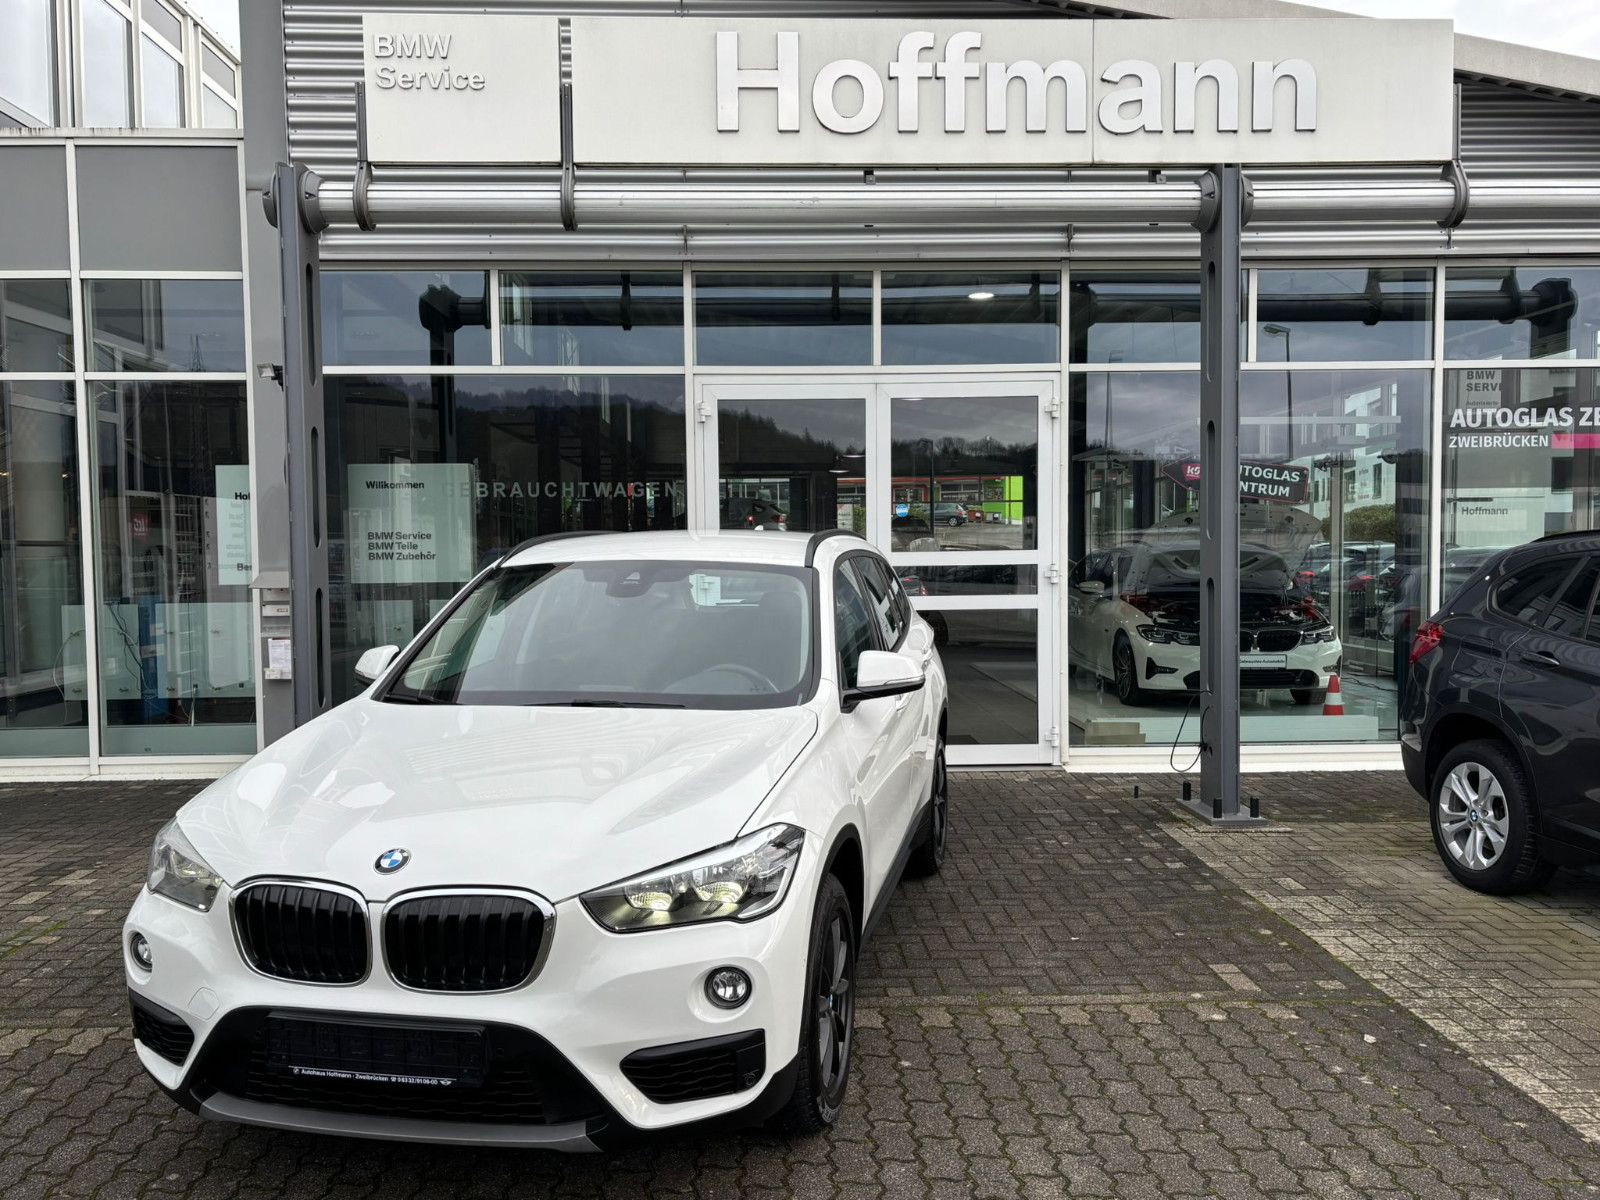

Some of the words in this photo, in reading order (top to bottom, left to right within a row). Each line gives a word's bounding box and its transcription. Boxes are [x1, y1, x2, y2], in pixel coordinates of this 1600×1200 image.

[373, 33, 451, 59] BMW
[376, 66, 486, 90] Service
[716, 30, 1318, 135] Hoffmann
[1466, 370, 1495, 380] BMW
[1466, 382, 1502, 392] SERVI
[1450, 406, 1573, 427] AUTOGLAS
[1578, 406, 1600, 426] ZE
[1449, 432, 1548, 448] ZWEIBRÜCKEN
[1240, 465, 1300, 482] TOGLAS
[365, 480, 425, 489] Willkommen
[1240, 481, 1290, 497] NTRUM
[1461, 506, 1508, 516] Hoffmann
[367, 531, 394, 540] BMW
[395, 531, 432, 540] Service
[367, 542, 394, 550] BMW
[395, 541, 419, 550] Teile
[368, 552, 394, 561] BMW
[396, 550, 436, 561] Zubehör
[301, 1068, 326, 1076] Autohaus
[326, 1071, 352, 1079] Hoffmann
[355, 1073, 389, 1081] Zweibrücken
